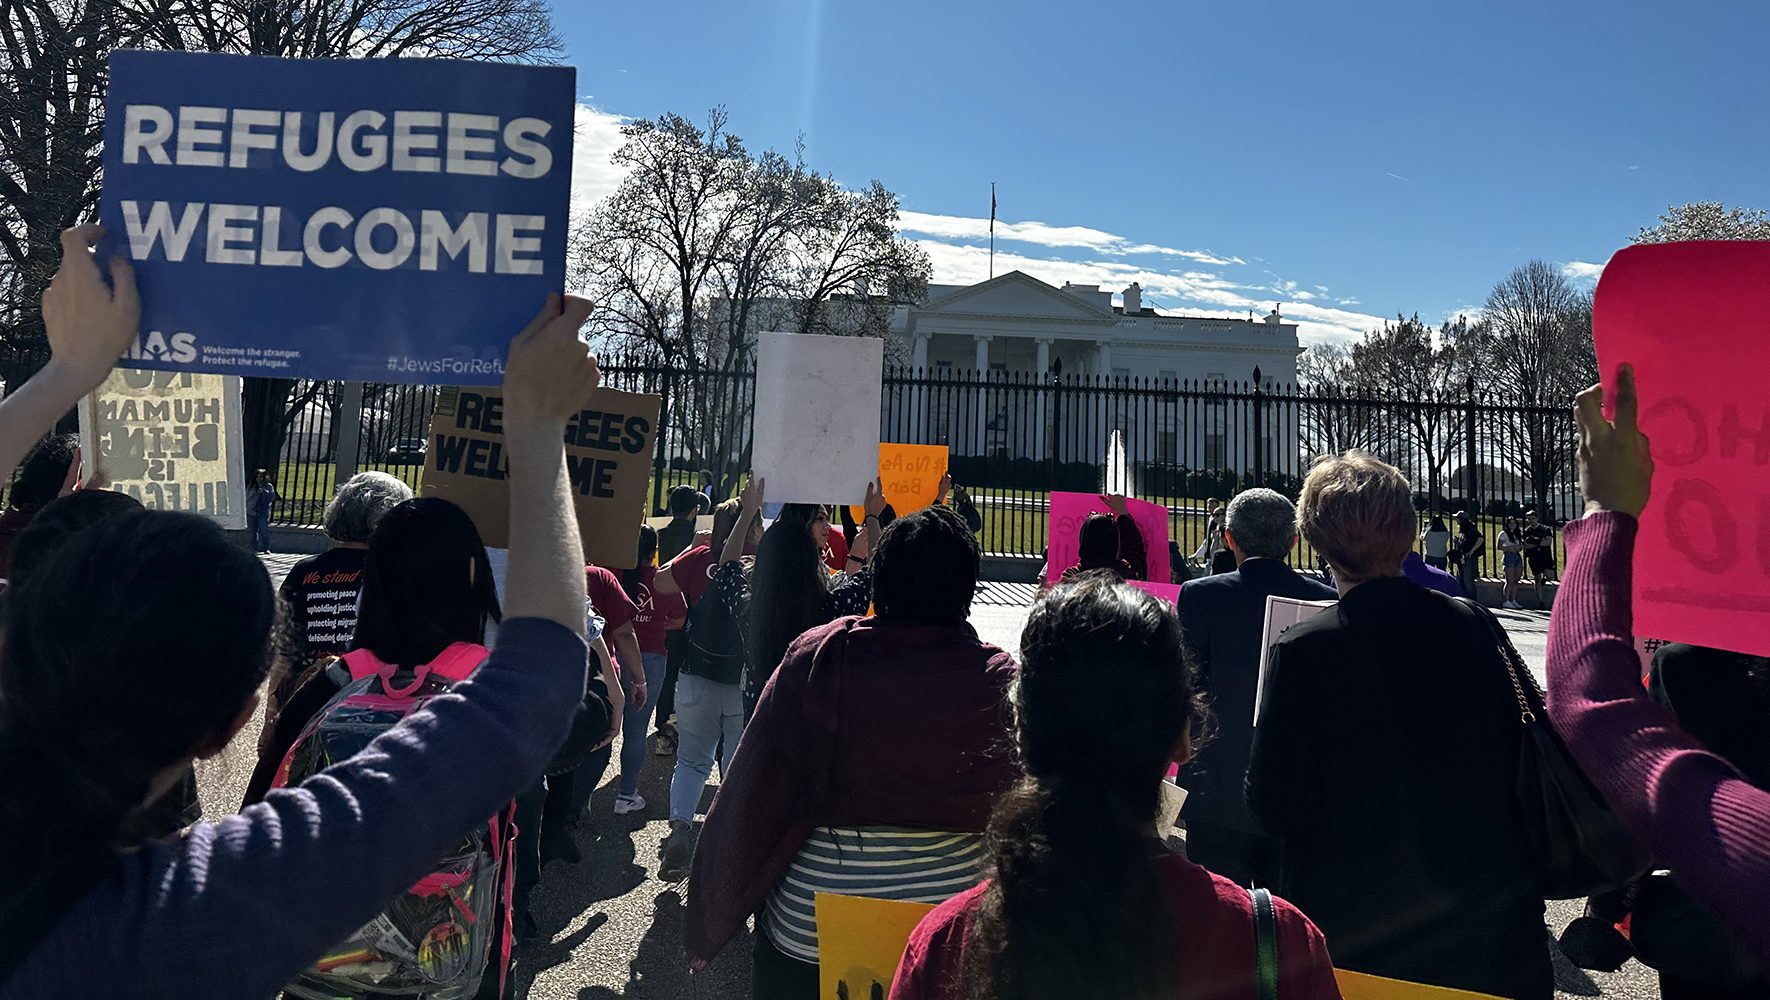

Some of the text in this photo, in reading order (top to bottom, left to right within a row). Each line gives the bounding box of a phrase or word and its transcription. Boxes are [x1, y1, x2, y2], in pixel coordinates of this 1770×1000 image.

[122, 104, 553, 179] REFUGEES
[120, 200, 546, 275] WELCOME
[120, 331, 197, 363] IAS
[203, 346, 300, 359] Welcome the stranger.
[202, 356, 290, 369] Protect the refugee.
[455, 392, 650, 454] REGEES
[435, 433, 618, 499] WELME
[303, 569, 361, 585] We stand
[307, 590, 356, 601] promoting peace
[307, 603, 357, 615] upholding justice
[308, 618, 337, 629] protecting
[308, 633, 335, 644] defending
